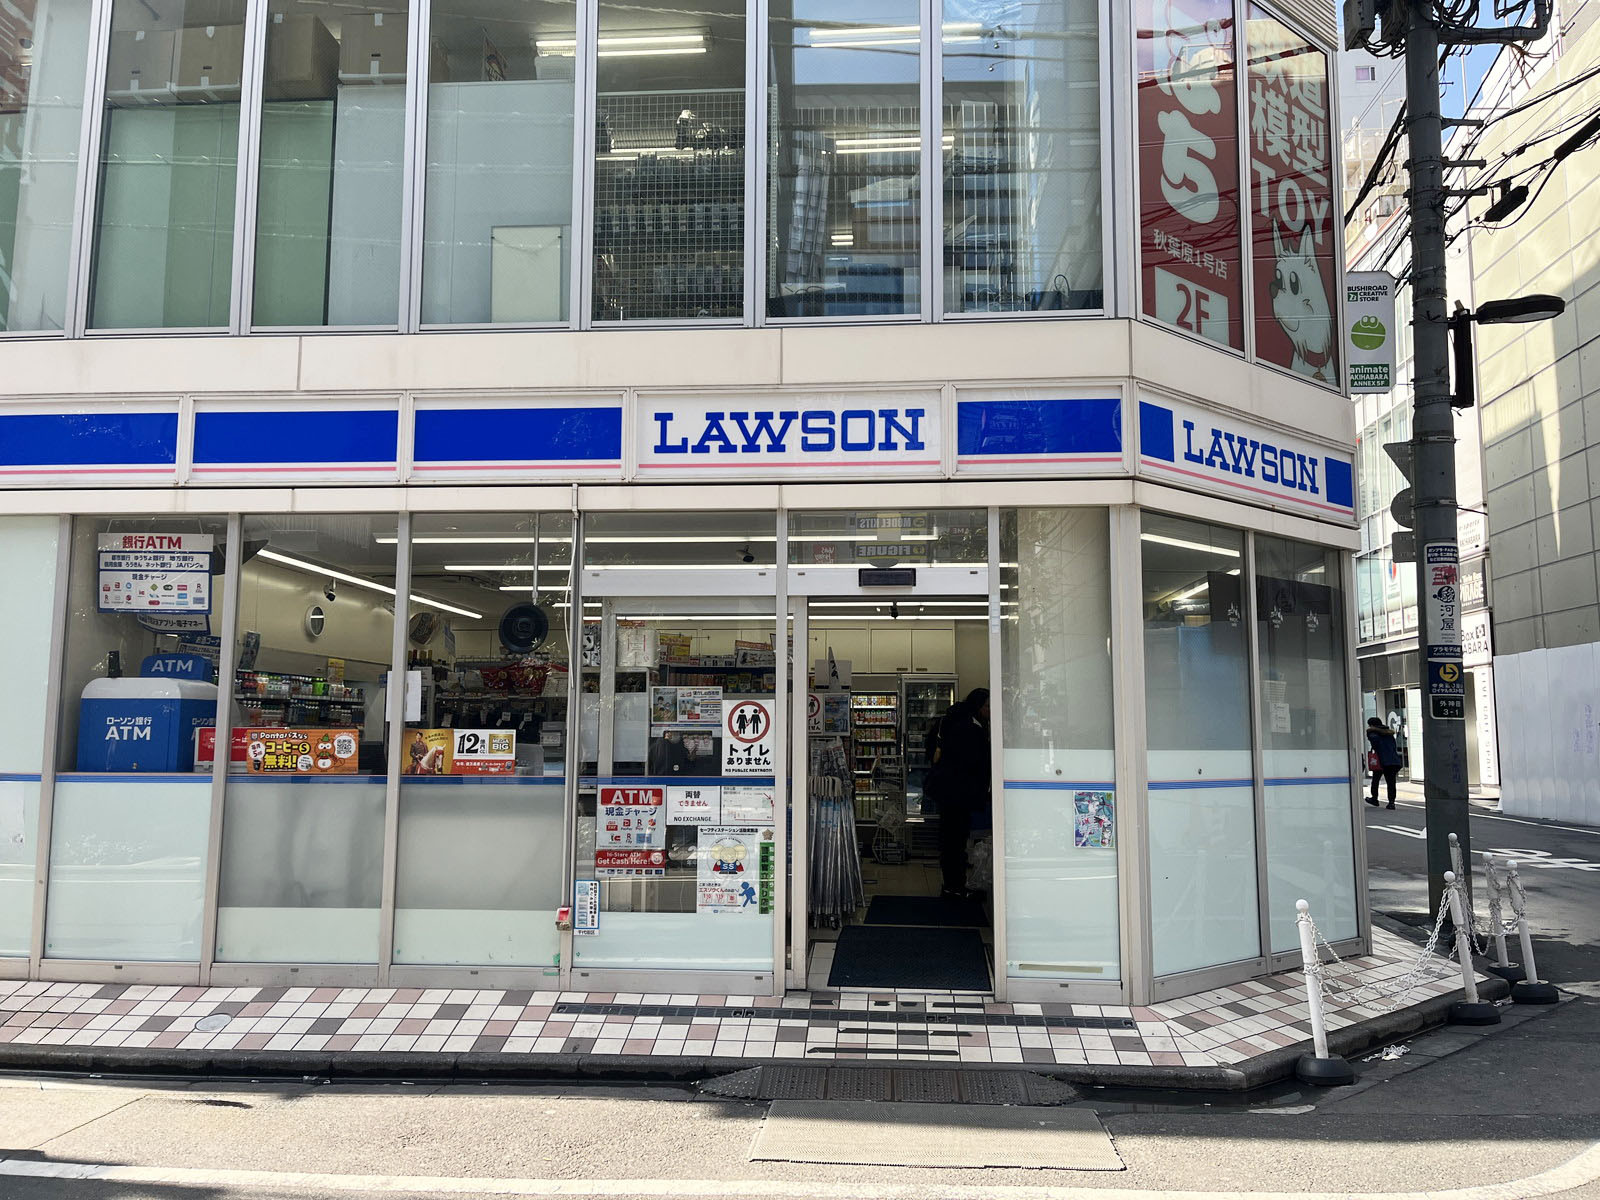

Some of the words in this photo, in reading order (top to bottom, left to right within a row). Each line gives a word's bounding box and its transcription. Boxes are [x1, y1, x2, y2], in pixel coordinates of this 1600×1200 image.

[1251, 79, 1327, 188] 模型
[1252, 157, 1330, 245] TOY
[1153, 229, 1228, 280] 秋葉原1号店
[1176, 283, 1210, 335] 2F
[1350, 365, 1389, 374] animate
[654, 408, 925, 453] LAWSON
[1183, 419, 1319, 495] LAWSON
[122, 535, 182, 550] 銀行ATM
[1437, 586, 1455, 630] 駿河屋
[1462, 640, 1489, 655] ABARA
[151, 660, 193, 672] ATM
[106, 716, 152, 726] ローソン銀行
[105, 726, 151, 741] ATM
[457, 733, 480, 754] 12
[730, 744, 769, 756] トイレ
[727, 757, 771, 765] ありません
[611, 790, 653, 805] ATM
[685, 790, 701, 799] 両替
[605, 807, 658, 816] 現金チャージ
